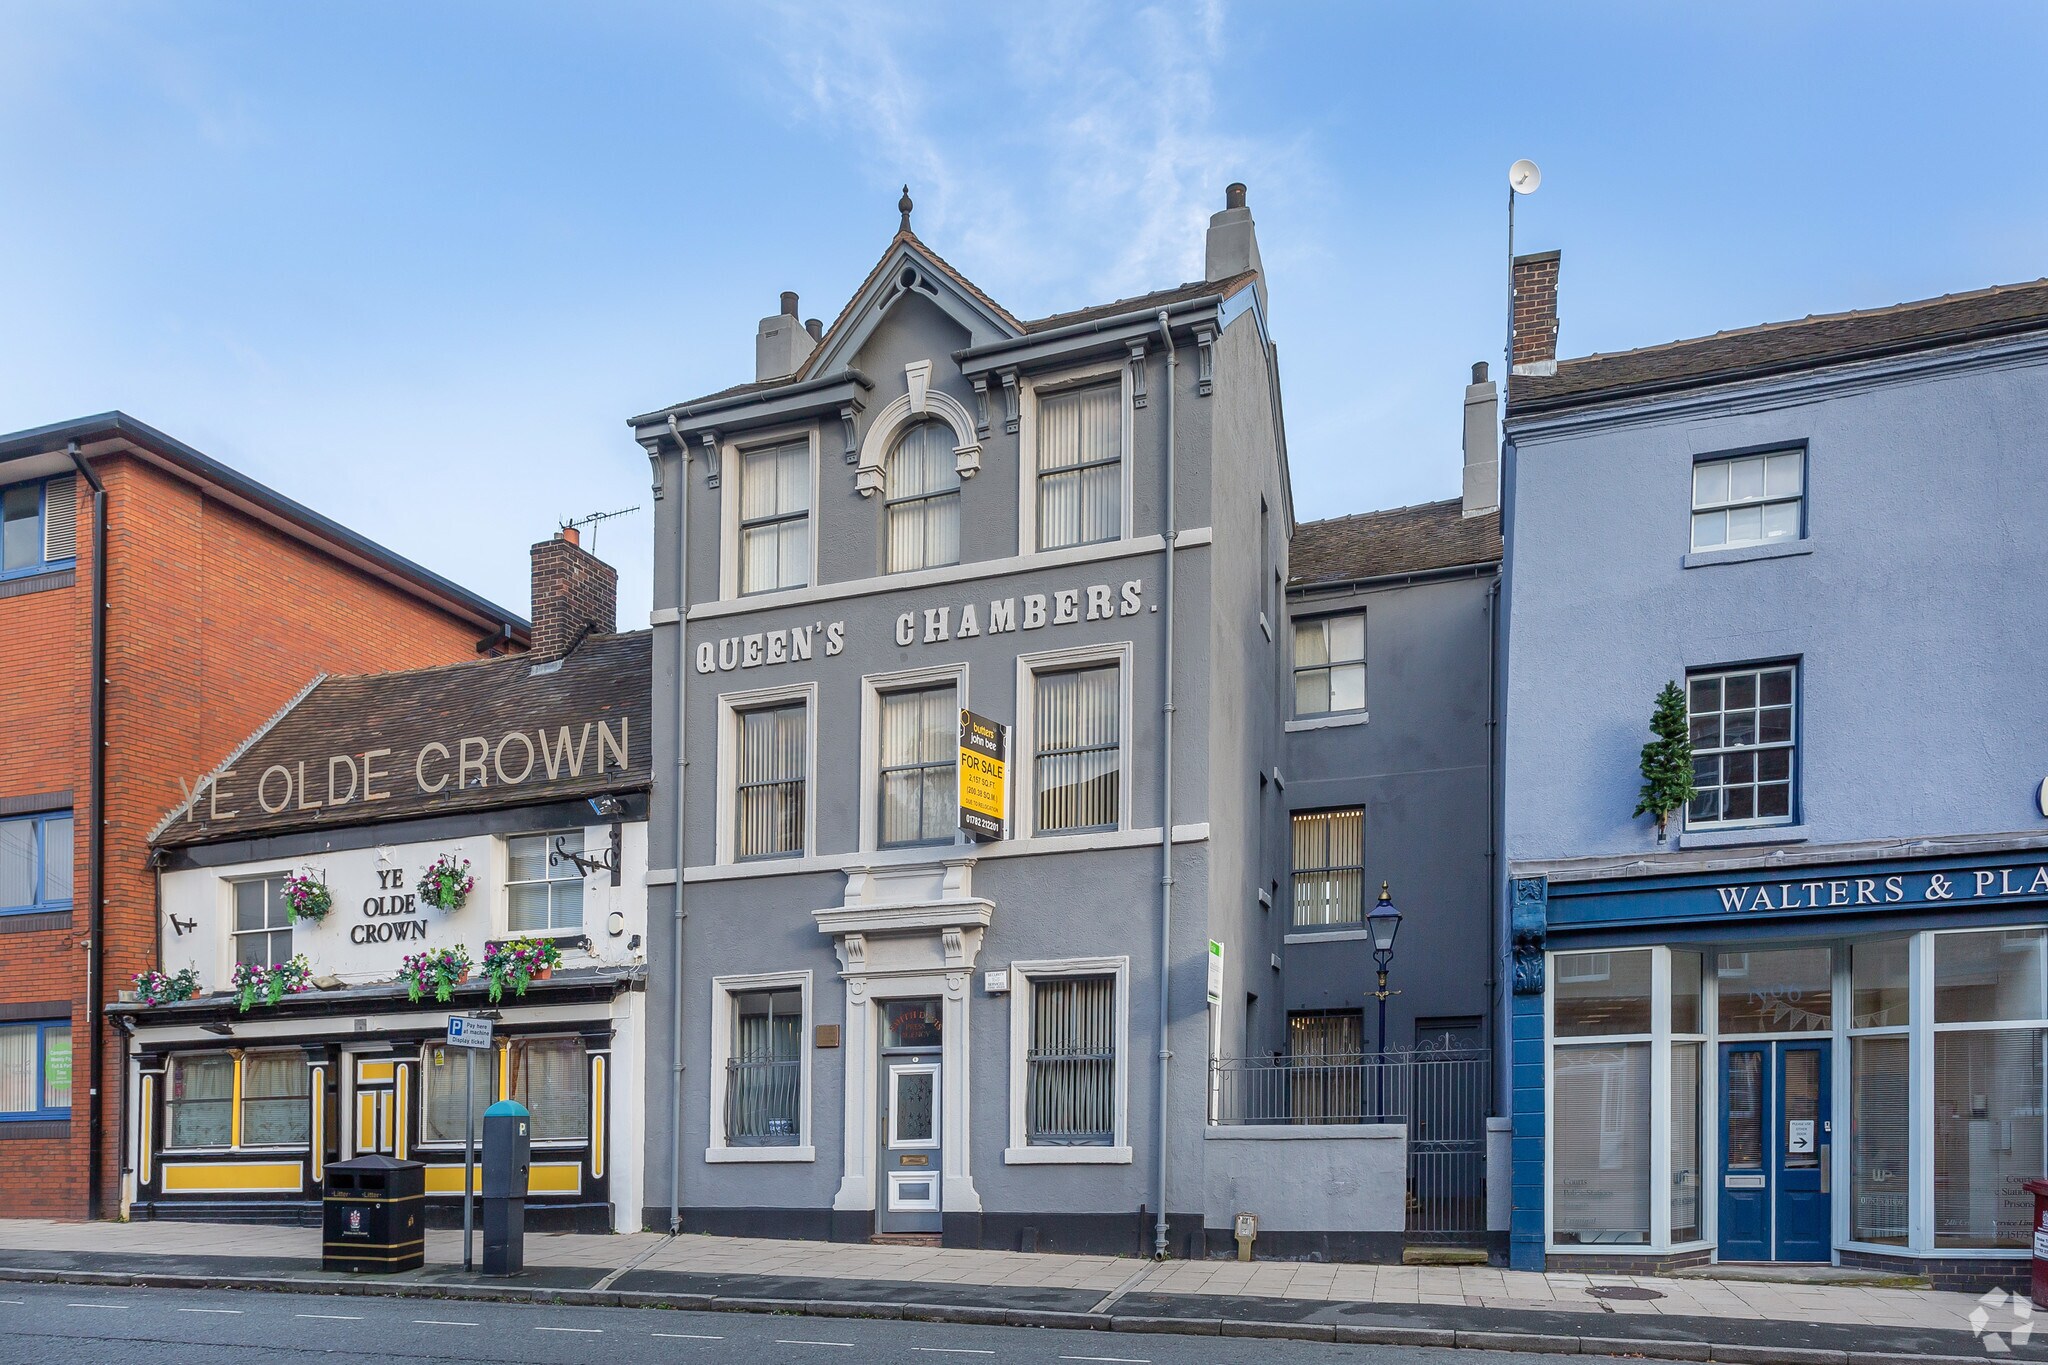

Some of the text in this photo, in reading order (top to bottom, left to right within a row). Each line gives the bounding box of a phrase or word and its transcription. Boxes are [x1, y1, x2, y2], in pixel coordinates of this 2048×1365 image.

[696, 620, 844, 674] QUEEN'S
[970, 732, 997, 751] john bee
[973, 722, 995, 740] butters
[179, 716, 629, 822] YE OLDE CROWN
[961, 752, 1003, 779] FOR SALE
[968, 774, 981, 784] 2,157
[965, 798, 973, 806] DUE
[966, 814, 982, 827] 01782
[376, 868, 404, 890] YE
[1716, 866, 2048, 912] WALTERS & PLA
[363, 893, 416, 917] OLDE
[350, 919, 428, 944] CROWN
[452, 1020, 461, 1035] P
[889, 1010, 918, 1032] SMITH
[519, 1123, 526, 1135] P
